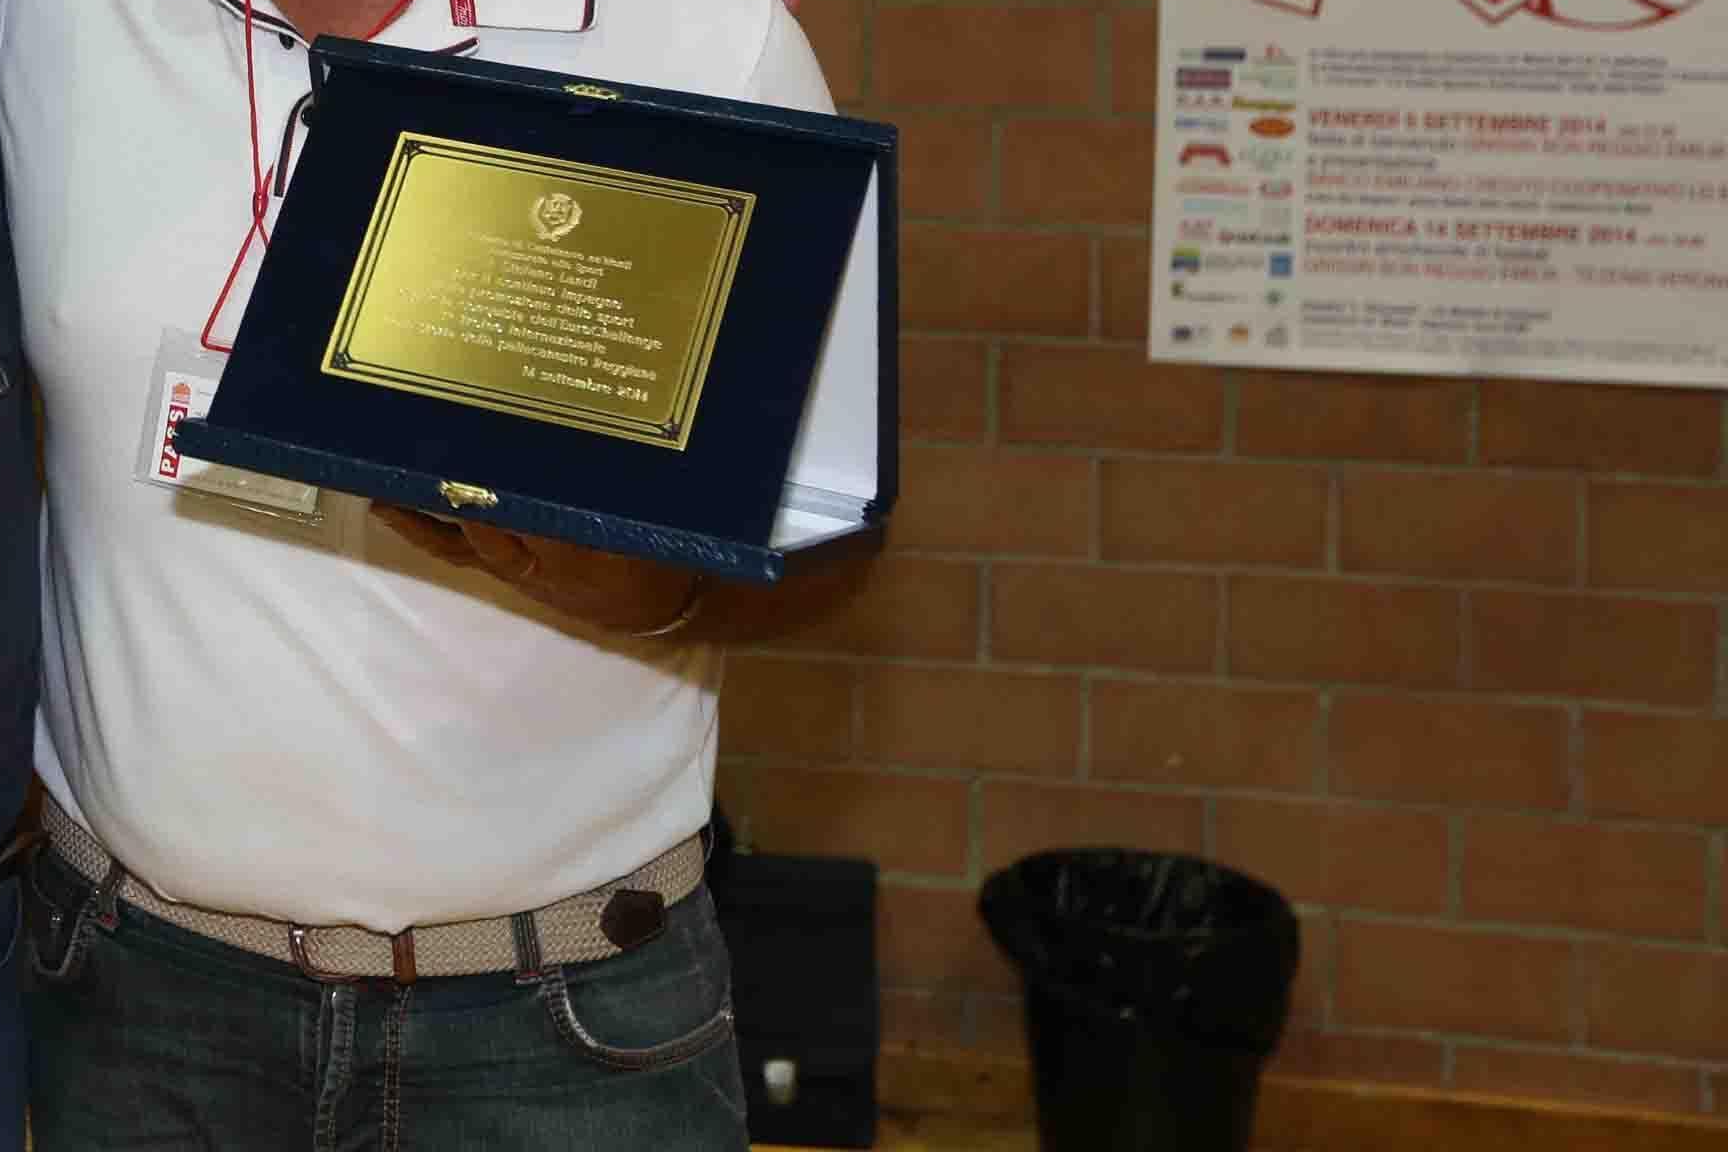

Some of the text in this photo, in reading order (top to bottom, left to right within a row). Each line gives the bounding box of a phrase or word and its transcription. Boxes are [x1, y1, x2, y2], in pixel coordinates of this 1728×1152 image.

[1454, 221, 1579, 243] SETTEMBRE
[596, 311, 636, 329] sport
[538, 368, 614, 396] settembre
[615, 383, 650, 404] 2014
